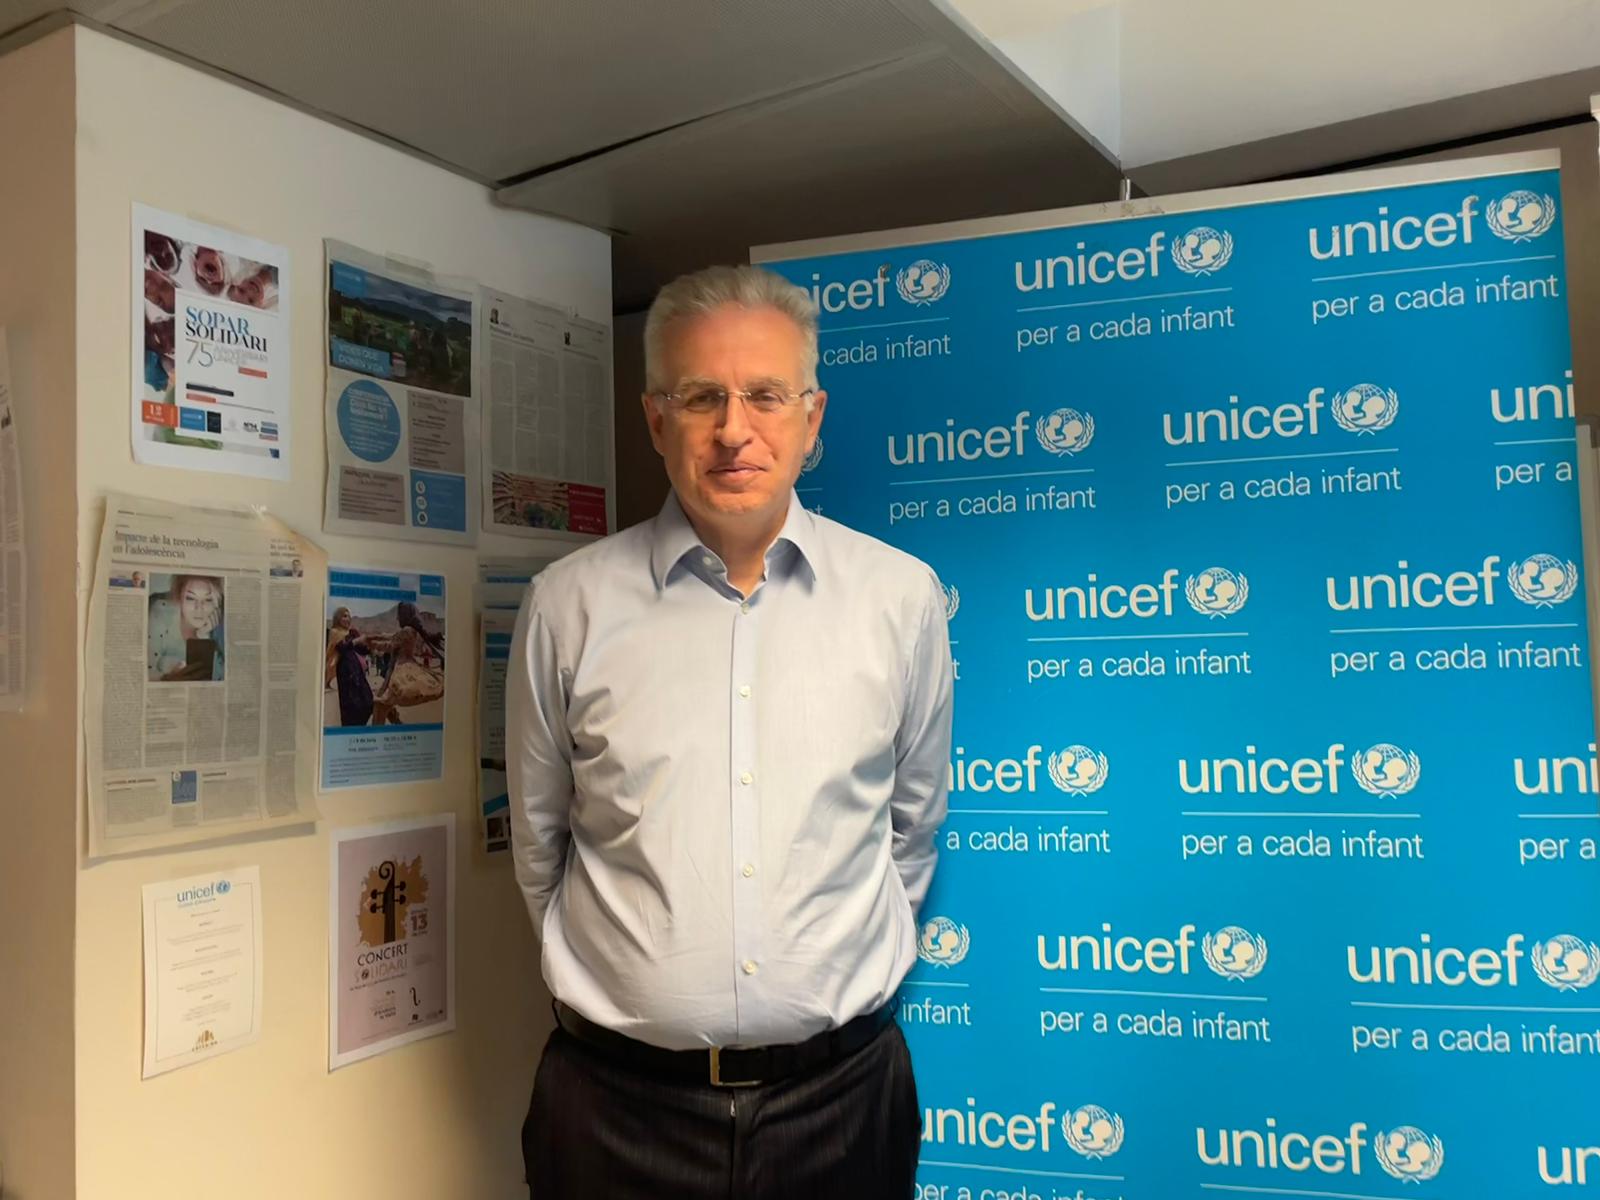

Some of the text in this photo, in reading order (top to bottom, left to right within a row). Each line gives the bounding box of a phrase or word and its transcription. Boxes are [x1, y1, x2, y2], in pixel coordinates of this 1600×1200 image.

[1308, 195, 1478, 260] unicef
[1014, 231, 1164, 292] unicef
[1311, 274, 1558, 324] per a cada infant
[185, 318, 267, 352] SOLIDARI
[186, 306, 250, 335] SOPAR
[1016, 305, 1234, 352] per a cada infant
[185, 338, 213, 367] 75
[823, 334, 950, 365] cada infant
[1162, 386, 1324, 445] unicef
[887, 410, 1030, 465] unicef
[1165, 466, 1402, 509] per a cada infant
[1495, 461, 1572, 490] per a
[889, 485, 1096, 524] per a cada infant
[149, 534, 161, 544] de
[162, 535, 171, 545] la
[173, 537, 219, 551] tecnologia
[1024, 568, 1179, 622] unicef
[1326, 554, 1500, 611] unicef
[1027, 647, 1251, 683] per a cada infant
[1330, 640, 1581, 678] per a cada infant
[1178, 742, 1344, 794] unicef
[946, 825, 1110, 852] a cada infant
[1181, 828, 1424, 860] per a cada infant
[1519, 837, 1596, 865] per a
[176, 882, 215, 903] unicef
[411, 912, 428, 931] 13
[357, 943, 409, 966] CONCERT
[1037, 922, 1196, 974] unicef
[1346, 932, 1524, 986] unicef
[354, 958, 408, 982] SOLIDARI
[902, 997, 971, 1025] infant
[1040, 1008, 1271, 1042] per a cada infant
[1351, 1025, 1402, 1053] per
[1411, 1028, 1428, 1050] a
[1438, 1023, 1510, 1053] cada
[1195, 1117, 1367, 1175] unicef
